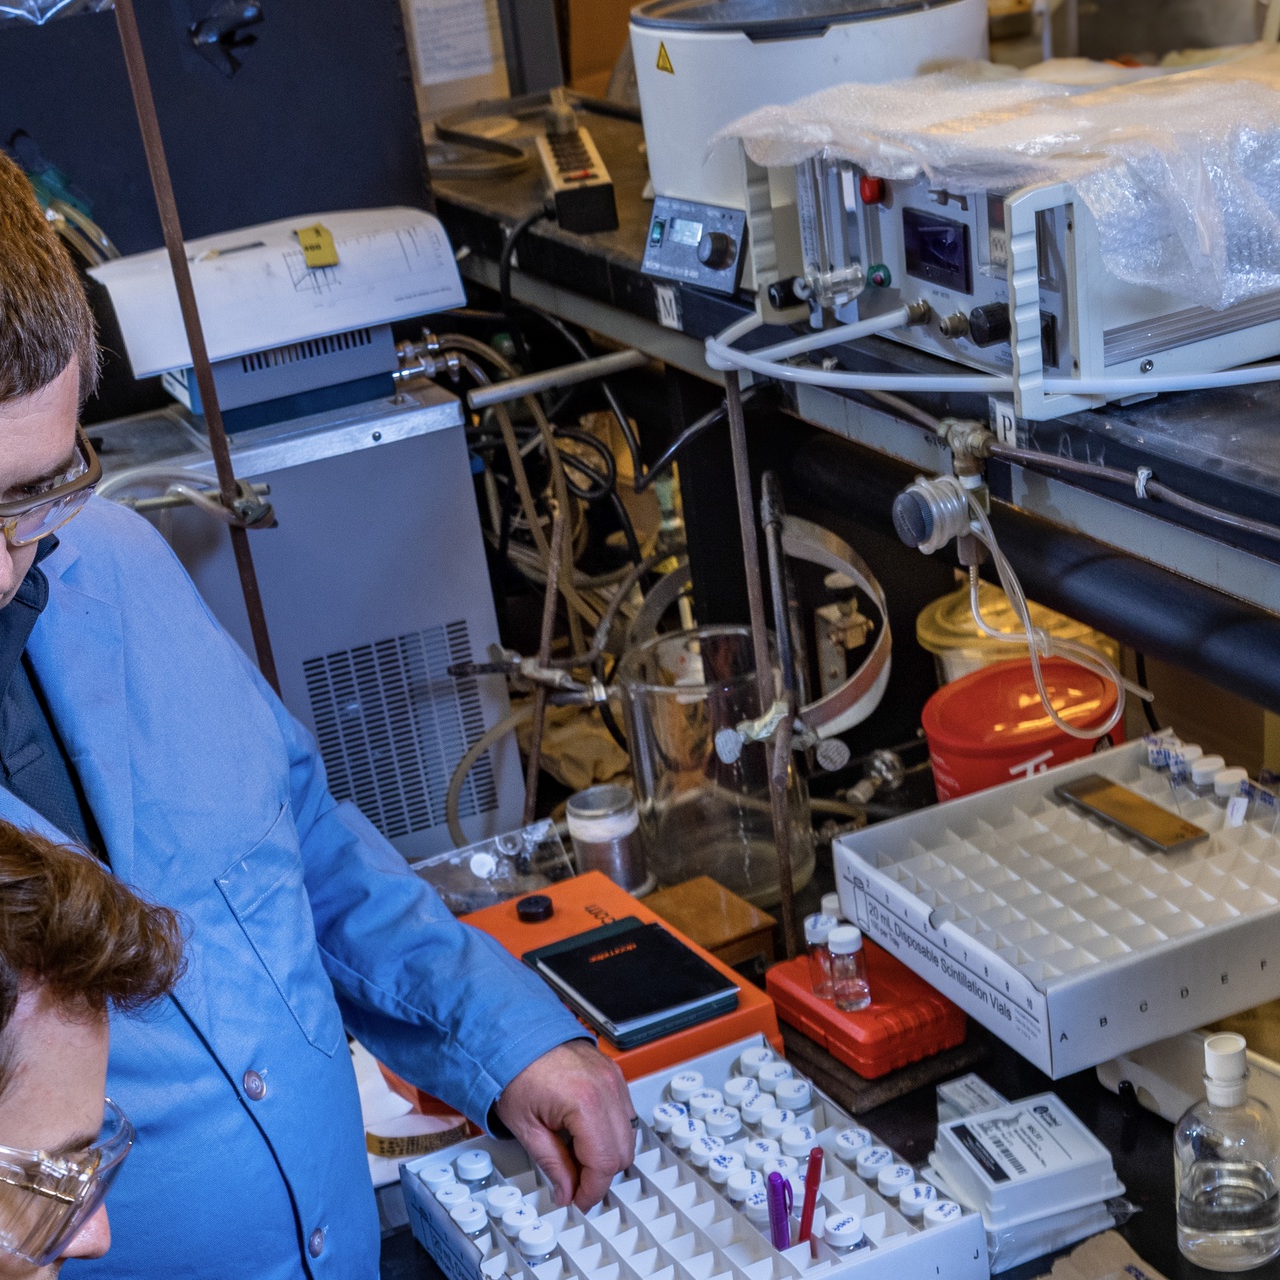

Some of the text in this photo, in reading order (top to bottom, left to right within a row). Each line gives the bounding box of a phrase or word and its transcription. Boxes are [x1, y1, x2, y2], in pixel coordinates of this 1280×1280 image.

[1001, 414, 1013, 442] P
[868, 902, 1013, 1022] 20 mL Disposable Scintillation Vials
[1059, 1032, 1069, 1043] A
[1099, 1017, 1108, 1028] B
[1139, 1003, 1148, 1014] C
[1180, 987, 1190, 999] D
[1221, 974, 1229, 985] E
[1260, 960, 1268, 971] F
[973, 1249, 980, 1260] J
